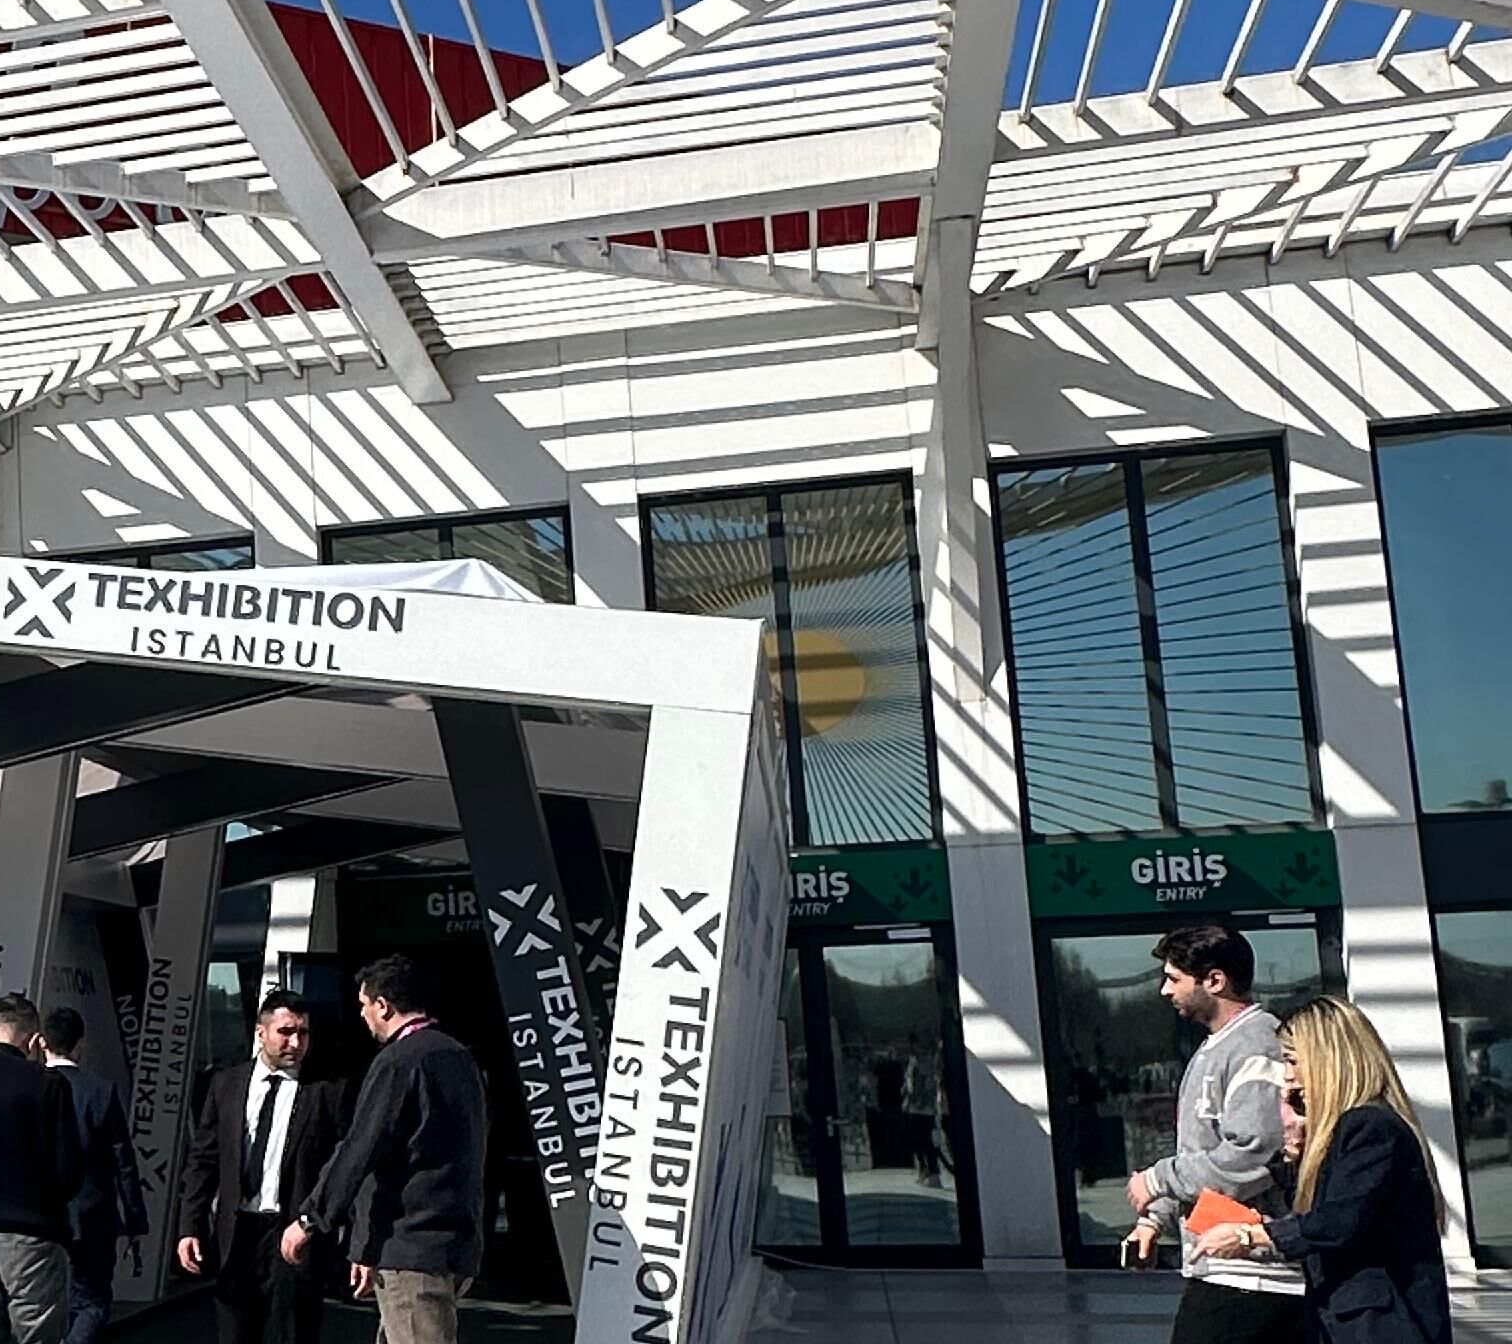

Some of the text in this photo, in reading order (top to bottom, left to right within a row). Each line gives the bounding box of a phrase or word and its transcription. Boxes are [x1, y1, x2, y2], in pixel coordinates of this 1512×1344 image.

[88, 572, 406, 634] TEXHIBITION
[130, 626, 342, 672] ISTANBUL
[789, 864, 850, 904] RİŞ
[1130, 847, 1228, 888] GİRİŞ
[1155, 886, 1207, 902] ENTRY
[426, 883, 479, 917] GİR
[445, 918, 482, 934] ENTR
[133, 958, 173, 1138] TEXHIBITION
[162, 994, 193, 1114] ISTANBUL
[536, 955, 604, 1204] TEXHIBI
[508, 1011, 577, 1209] ISTANBUL
[588, 1036, 645, 1272] ISTANBUL
